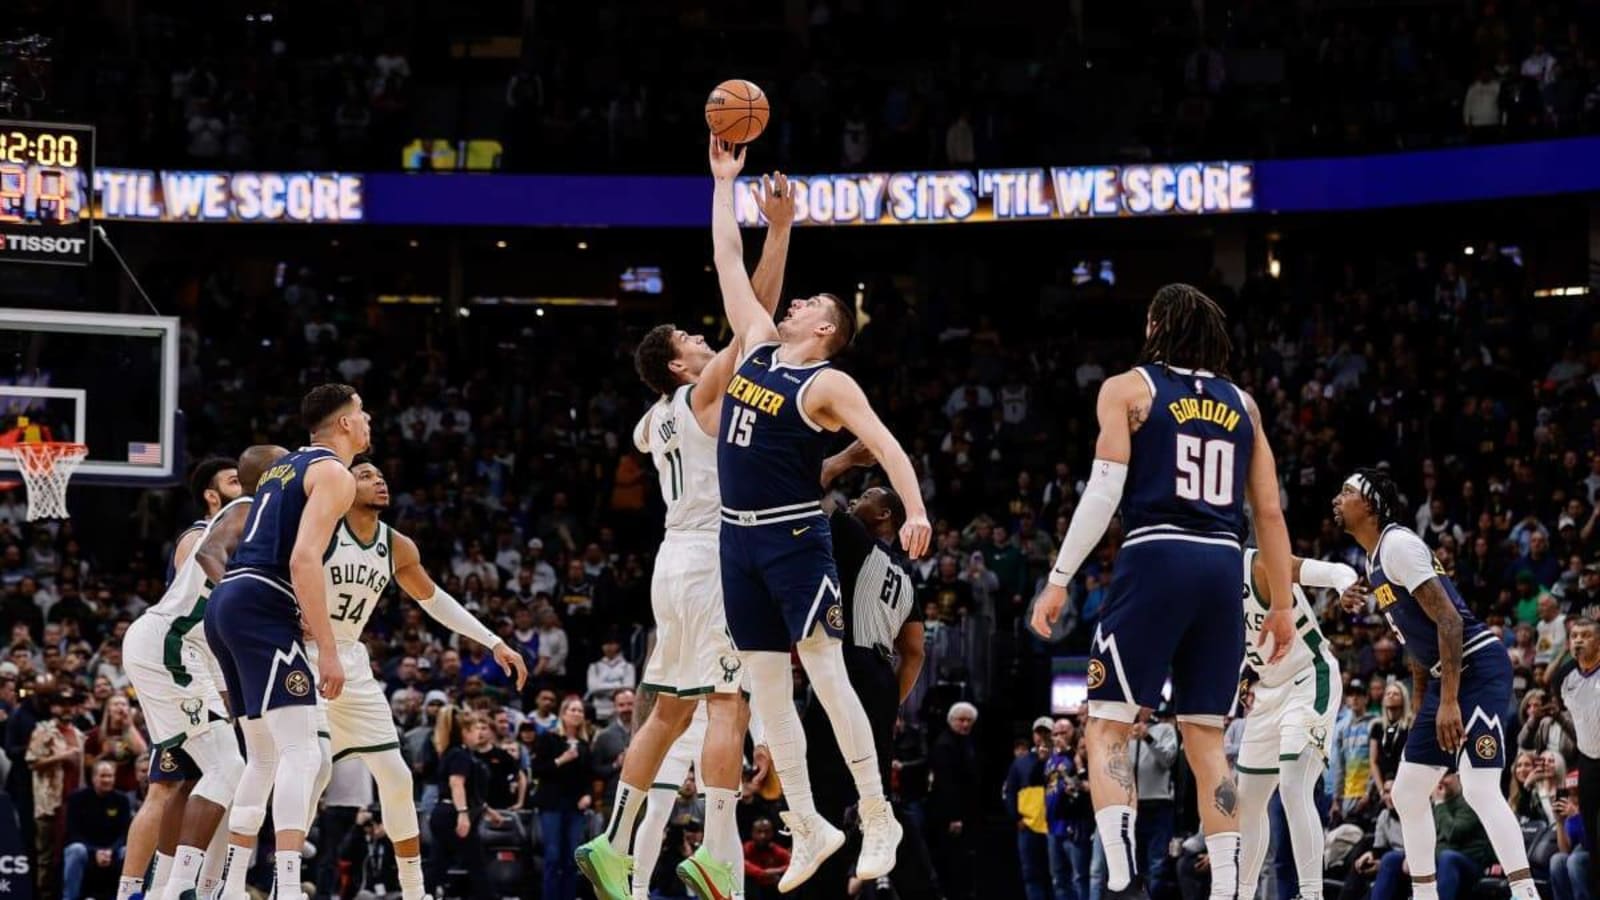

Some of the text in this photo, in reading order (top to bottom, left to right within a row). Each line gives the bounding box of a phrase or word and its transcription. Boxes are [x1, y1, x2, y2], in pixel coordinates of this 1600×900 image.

[163, 172, 229, 220] WE
[231, 172, 363, 221] SCORE
[734, 176, 884, 224] NBODY
[888, 172, 977, 221] SITS
[1055, 167, 1118, 216] WE
[1122, 163, 1254, 214] SCORE
[6, 234, 86, 254] TISSOT
[726, 374, 785, 417] DENVER
[1168, 398, 1241, 432] GORDON
[726, 405, 757, 447] 15
[664, 448, 684, 501] 11
[1176, 433, 1235, 506] 50
[244, 492, 271, 543] 1
[330, 563, 388, 594] BUCKS
[880, 566, 902, 610] 21
[330, 593, 367, 624] 34
